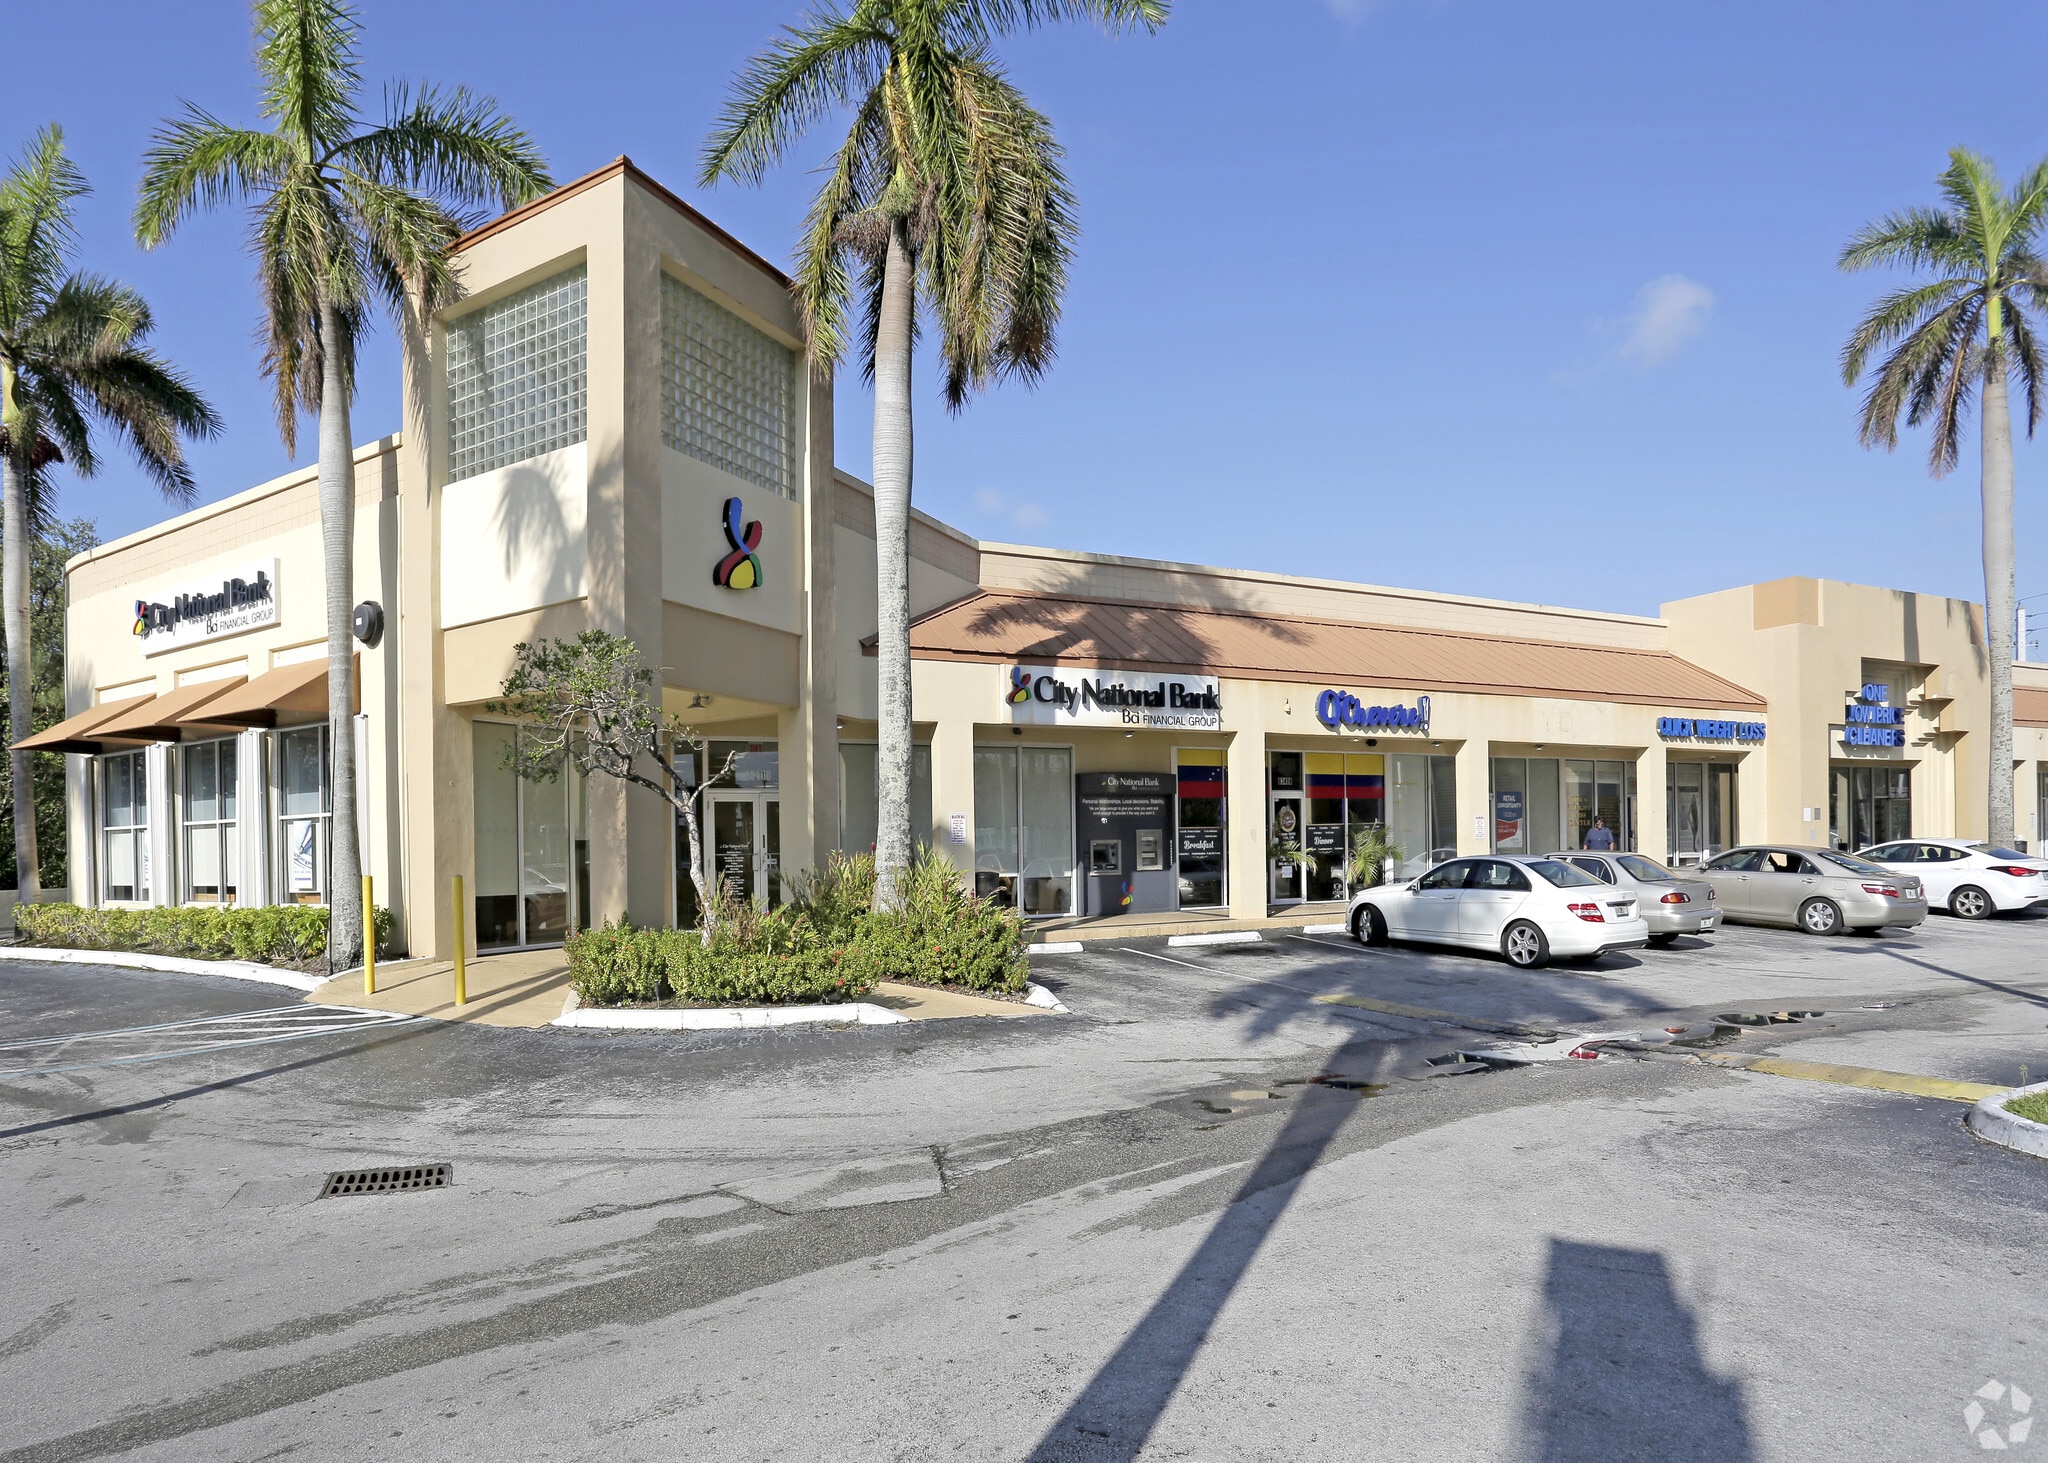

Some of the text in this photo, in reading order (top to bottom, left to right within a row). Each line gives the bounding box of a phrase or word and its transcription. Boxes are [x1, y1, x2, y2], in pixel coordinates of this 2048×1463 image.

[150, 571, 271, 632] City National Bank
[206, 608, 274, 635] Bci FINANCIAL GROUP
[1034, 675, 1220, 710] City National Bank
[1862, 683, 1889, 702] ONE
[1122, 708, 1218, 727] Bci FINANCIAL GROUP
[1846, 704, 1905, 725] LOW PRICE
[1658, 716, 1767, 741] QUICK WEIGHT LOSS
[1846, 727, 1905, 747] CLEANERS
[1107, 776, 1159, 787] City National Bank
[1184, 839, 1214, 851] Breakfast
[1313, 835, 1334, 846] Dinner
